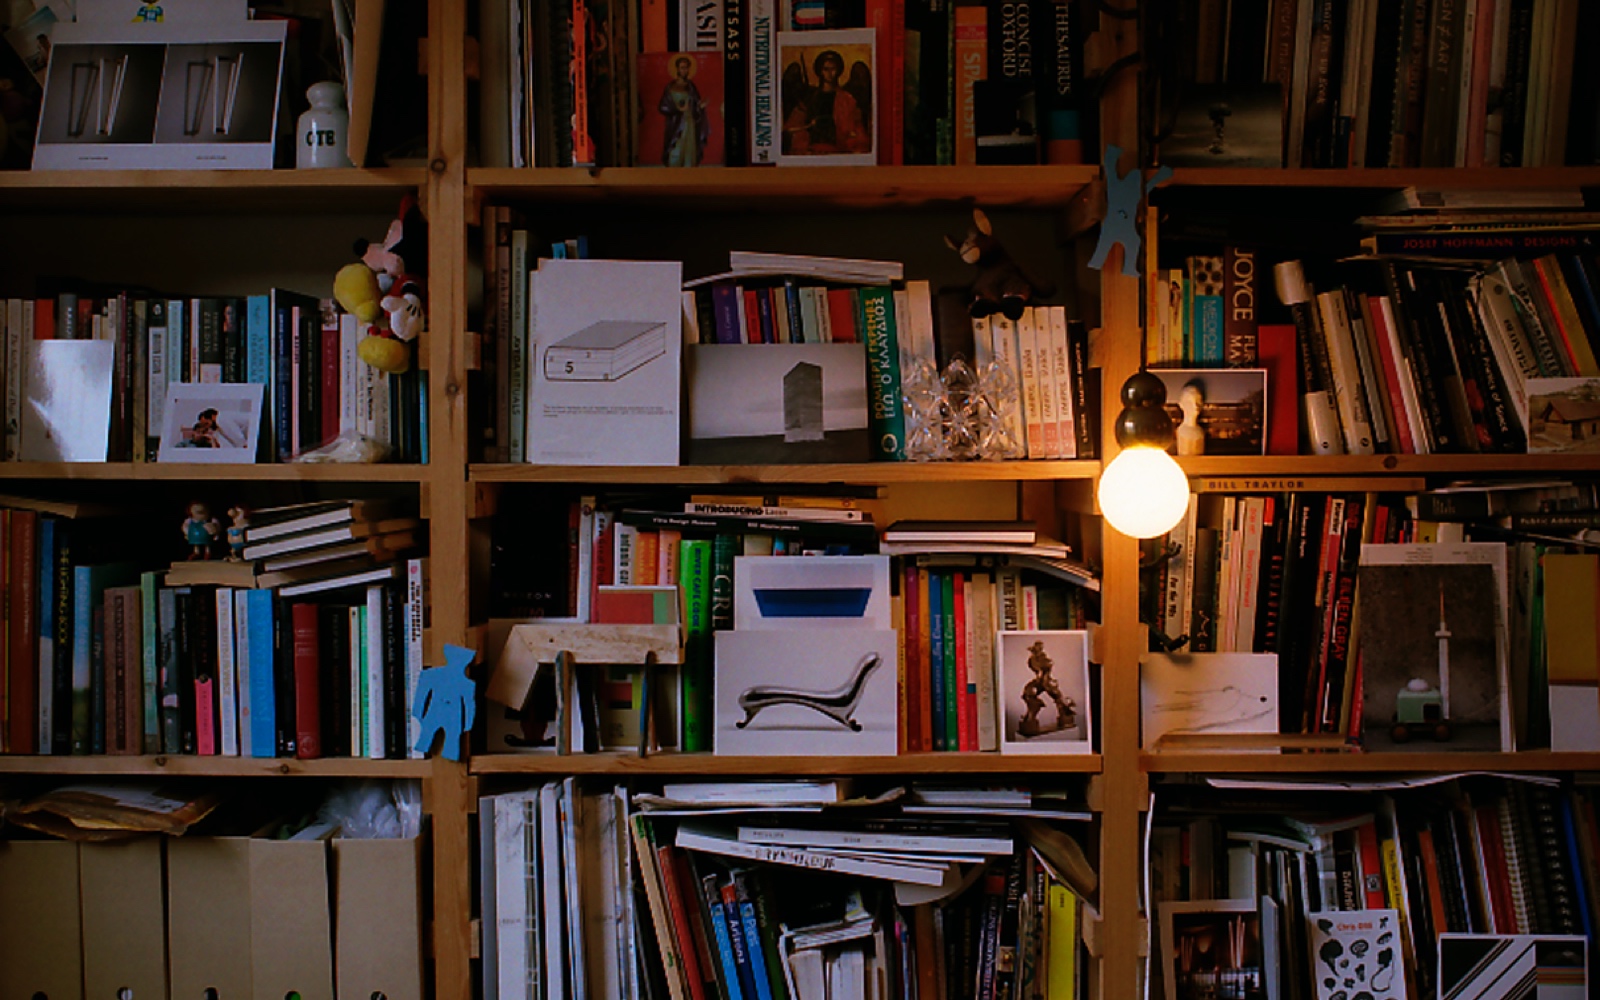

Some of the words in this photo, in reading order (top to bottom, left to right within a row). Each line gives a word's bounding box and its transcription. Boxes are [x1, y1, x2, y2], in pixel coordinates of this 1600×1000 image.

[754, 16, 770, 92] NUTRITIONAL
[1002, 3, 1017, 77] OXFORD
[1016, 2, 1032, 76] CONCISE
[1054, 4, 1072, 96] THESAURUS
[755, 95, 771, 147] HEALING
[1402, 238, 1437, 250] JOSEF
[1443, 237, 1514, 249] HOFFMANN
[1524, 236, 1578, 247] DESIGNS
[1231, 246, 1255, 322] JOYCE
[1208, 300, 1218, 362] MEDICINE
[565, 361, 574, 373] 5
[511, 372, 521, 416] RITUALS
[1208, 481, 1237, 489] BILL
[1245, 481, 1305, 489] TRAYLOR
[694, 504, 764, 516] INTRODUCING
[1520, 517, 1550, 525] Public
[1551, 517, 1588, 525] Address
[59, 547, 70, 564] THE
[58, 566, 69, 614] LIGHTING
[58, 616, 68, 646] BOOK
[1333, 625, 1346, 660] GRAY
